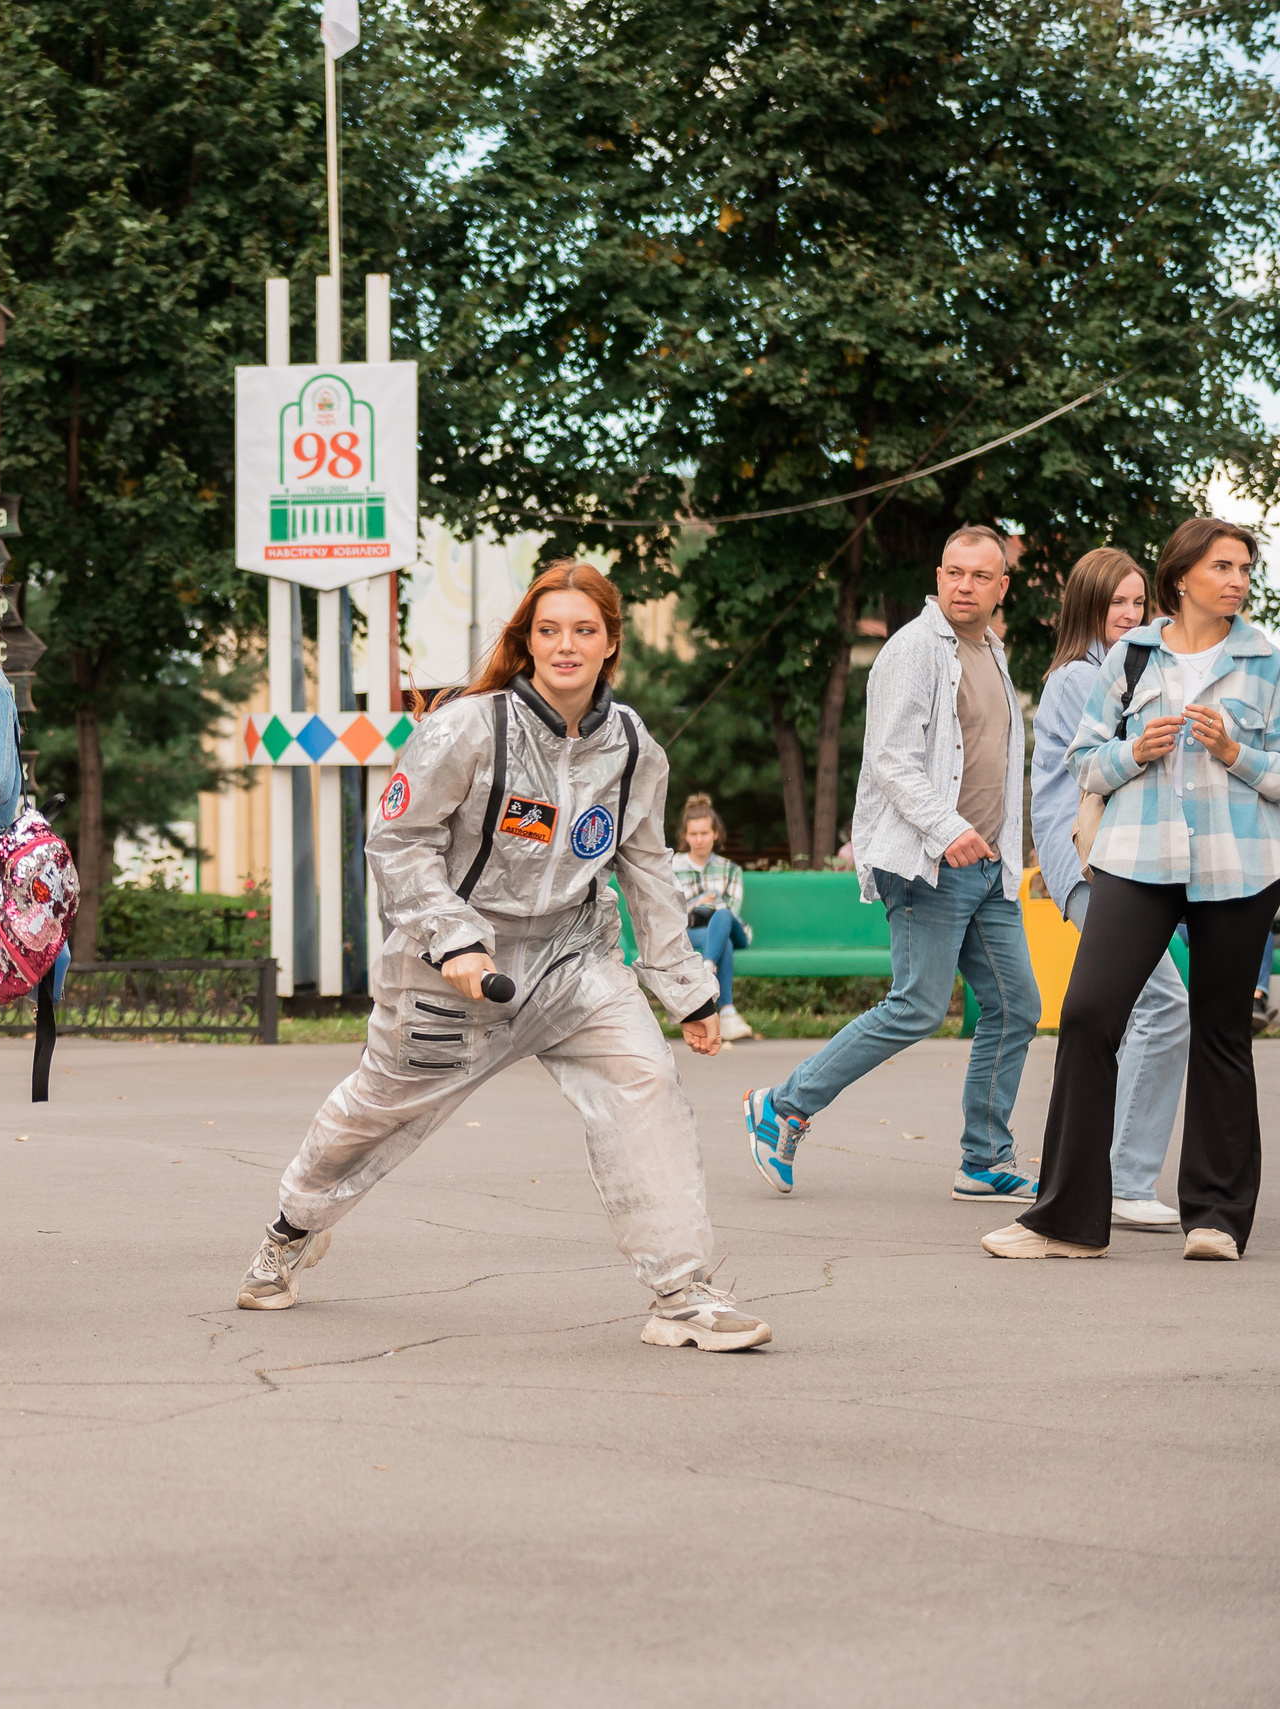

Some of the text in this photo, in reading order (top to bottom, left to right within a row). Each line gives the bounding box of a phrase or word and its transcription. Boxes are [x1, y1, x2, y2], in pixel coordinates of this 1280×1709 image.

[293, 431, 362, 480] 98
[268, 546, 388, 558] НАВСТРЕЧУ ЮБИЛЕЮ!
[506, 826, 546, 840] ASTRONAUT
